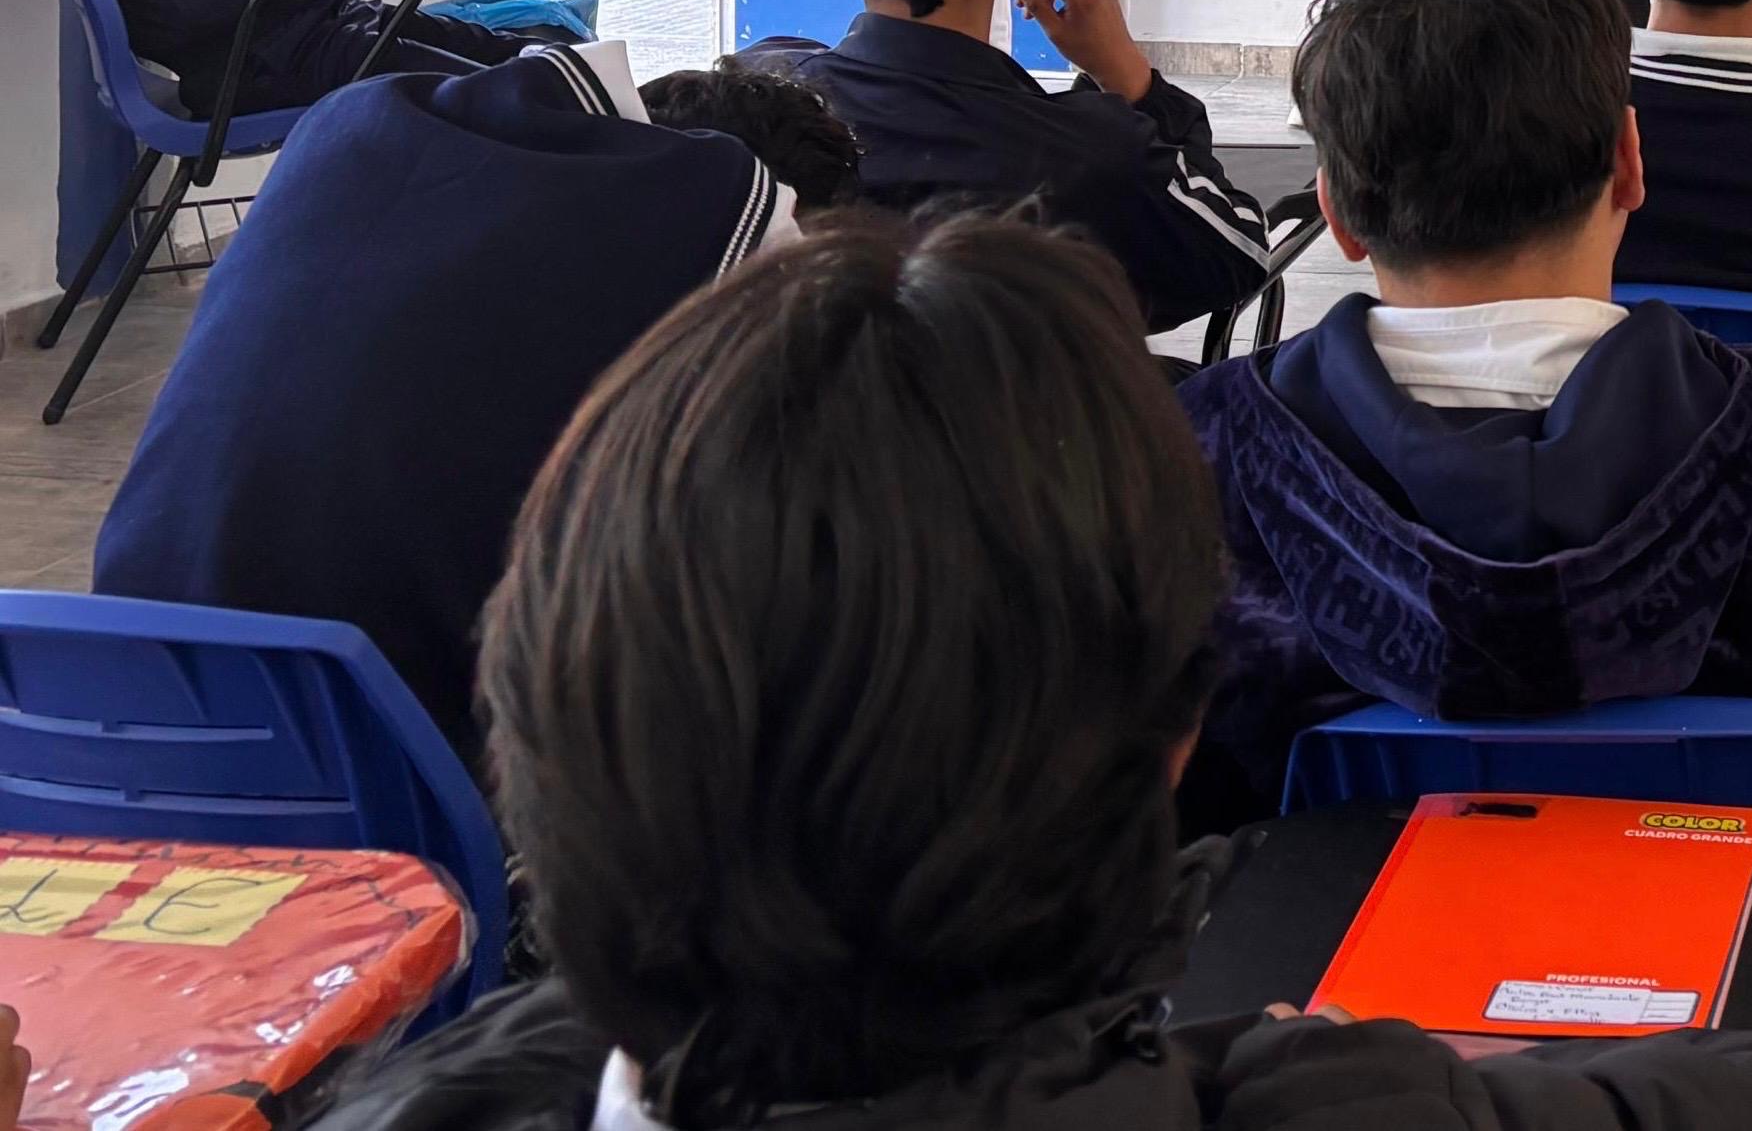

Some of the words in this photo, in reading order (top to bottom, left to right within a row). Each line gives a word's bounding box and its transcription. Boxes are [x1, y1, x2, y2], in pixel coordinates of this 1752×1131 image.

[1645, 814, 1741, 832] COLOR
[1624, 829, 1689, 840] CUADRO
[1546, 973, 1661, 987] PROFESIONAL
